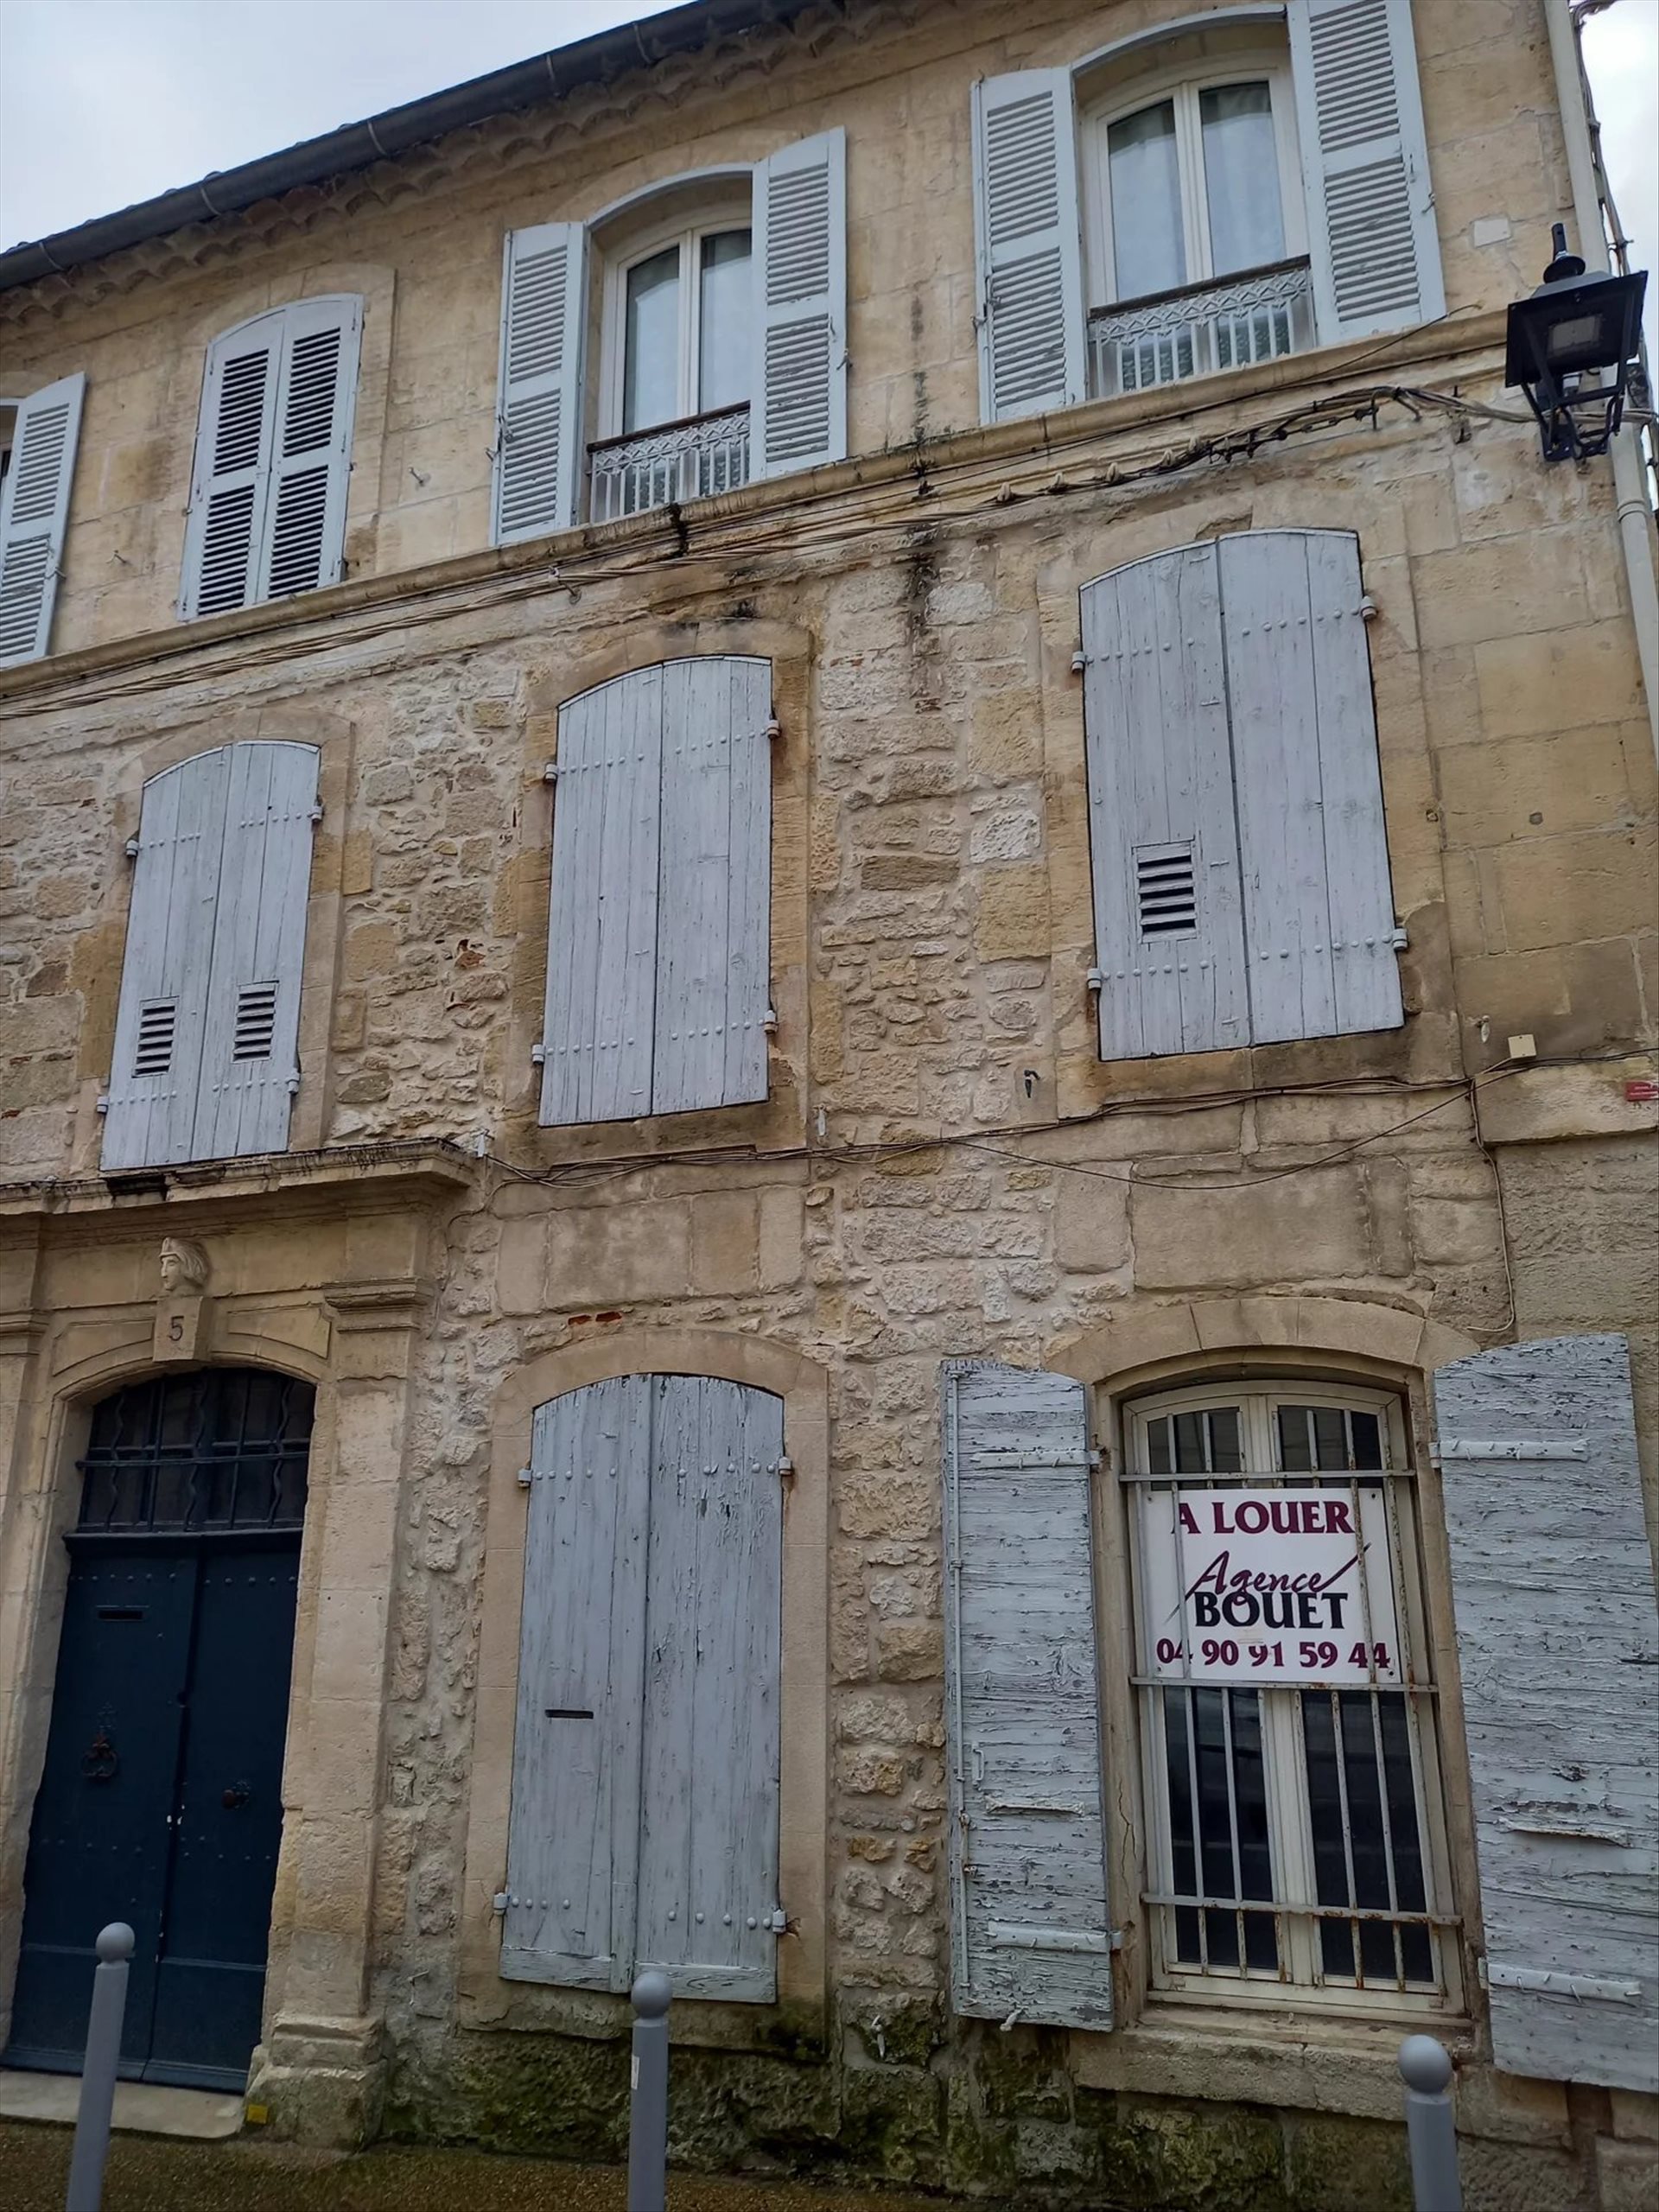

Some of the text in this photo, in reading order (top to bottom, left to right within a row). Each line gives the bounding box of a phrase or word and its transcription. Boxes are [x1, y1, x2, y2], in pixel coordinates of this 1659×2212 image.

[168, 1315, 185, 1341] 5
[1171, 1500, 1356, 1535] A LOUER
[1181, 1549, 1359, 1606] Agence
[1193, 1591, 1349, 1630] BOUET
[1201, 1639, 1239, 1666] 90
[1248, 1641, 1285, 1667] 91
[1299, 1641, 1338, 1669] 59
[1348, 1643, 1390, 1669] 44
